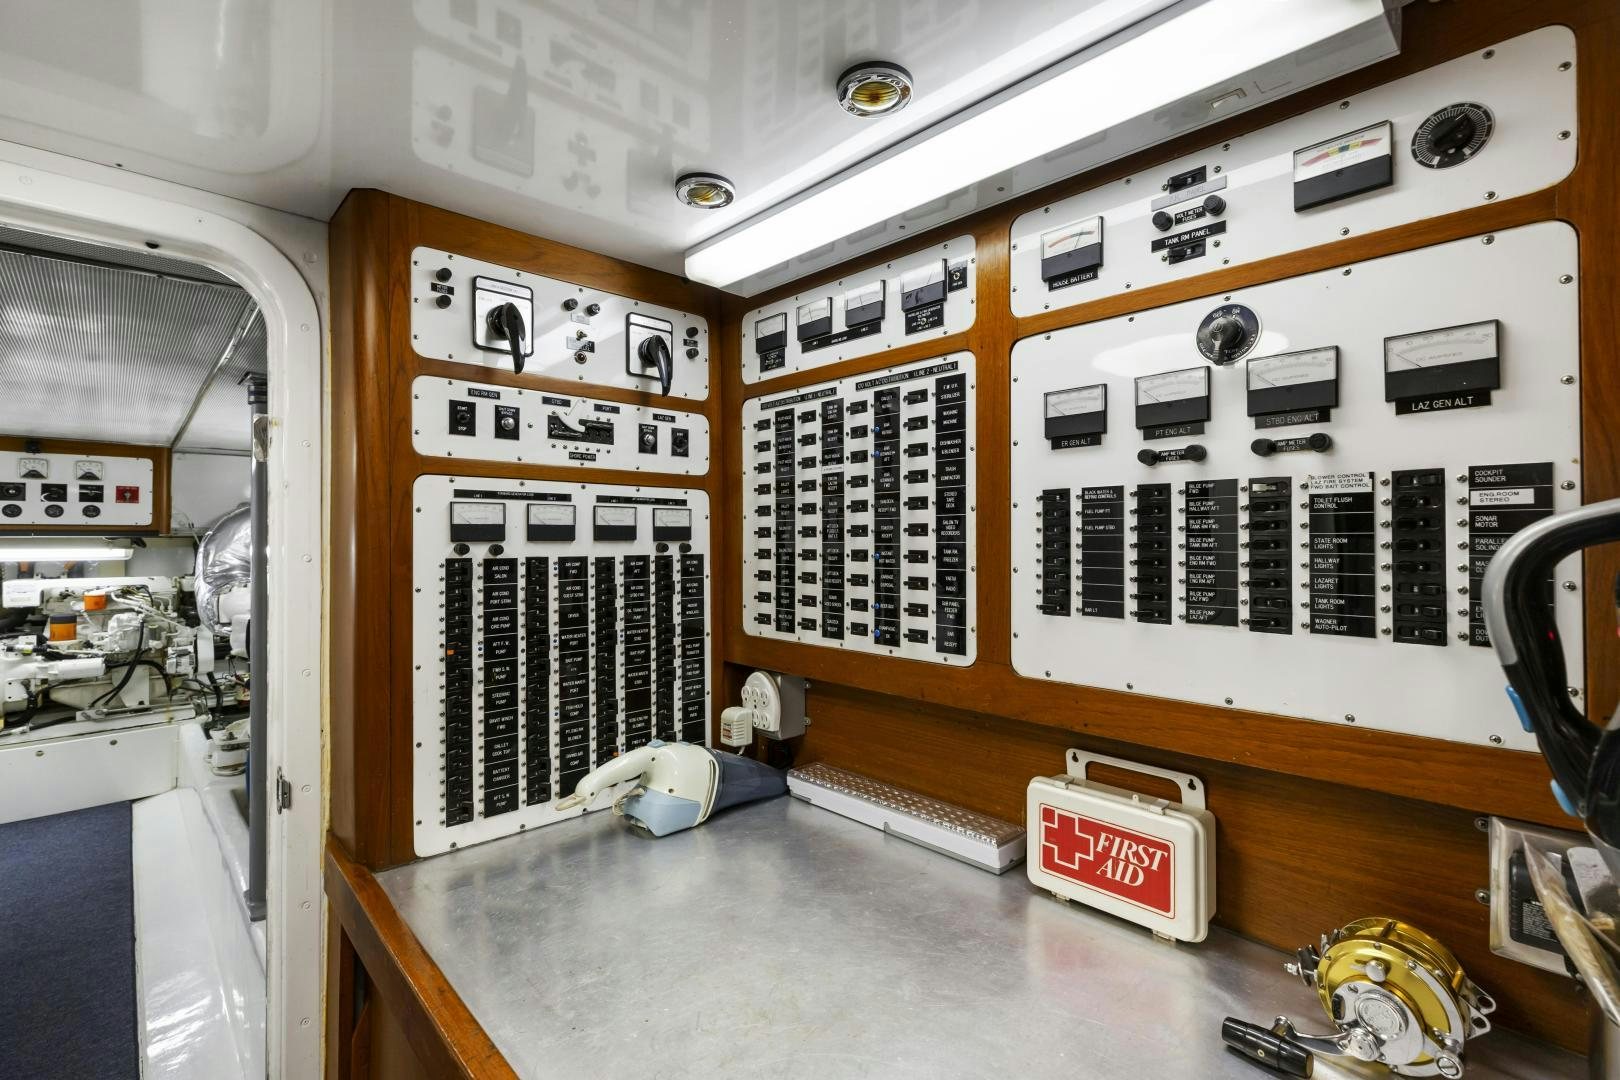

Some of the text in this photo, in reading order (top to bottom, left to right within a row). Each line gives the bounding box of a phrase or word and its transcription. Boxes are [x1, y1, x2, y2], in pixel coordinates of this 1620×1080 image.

[1188, 206, 1203, 215] METER
[1165, 237, 1180, 246] TANK
[1192, 228, 1210, 238] PANEL
[1053, 272, 1094, 288] HOUSE BATTERY
[1412, 396, 1474, 411] LAZ GEN ALT
[1266, 411, 1319, 426] STBD ENG ALT
[1096, 832, 1168, 872] FIRST
[1096, 858, 1144, 886] AID
